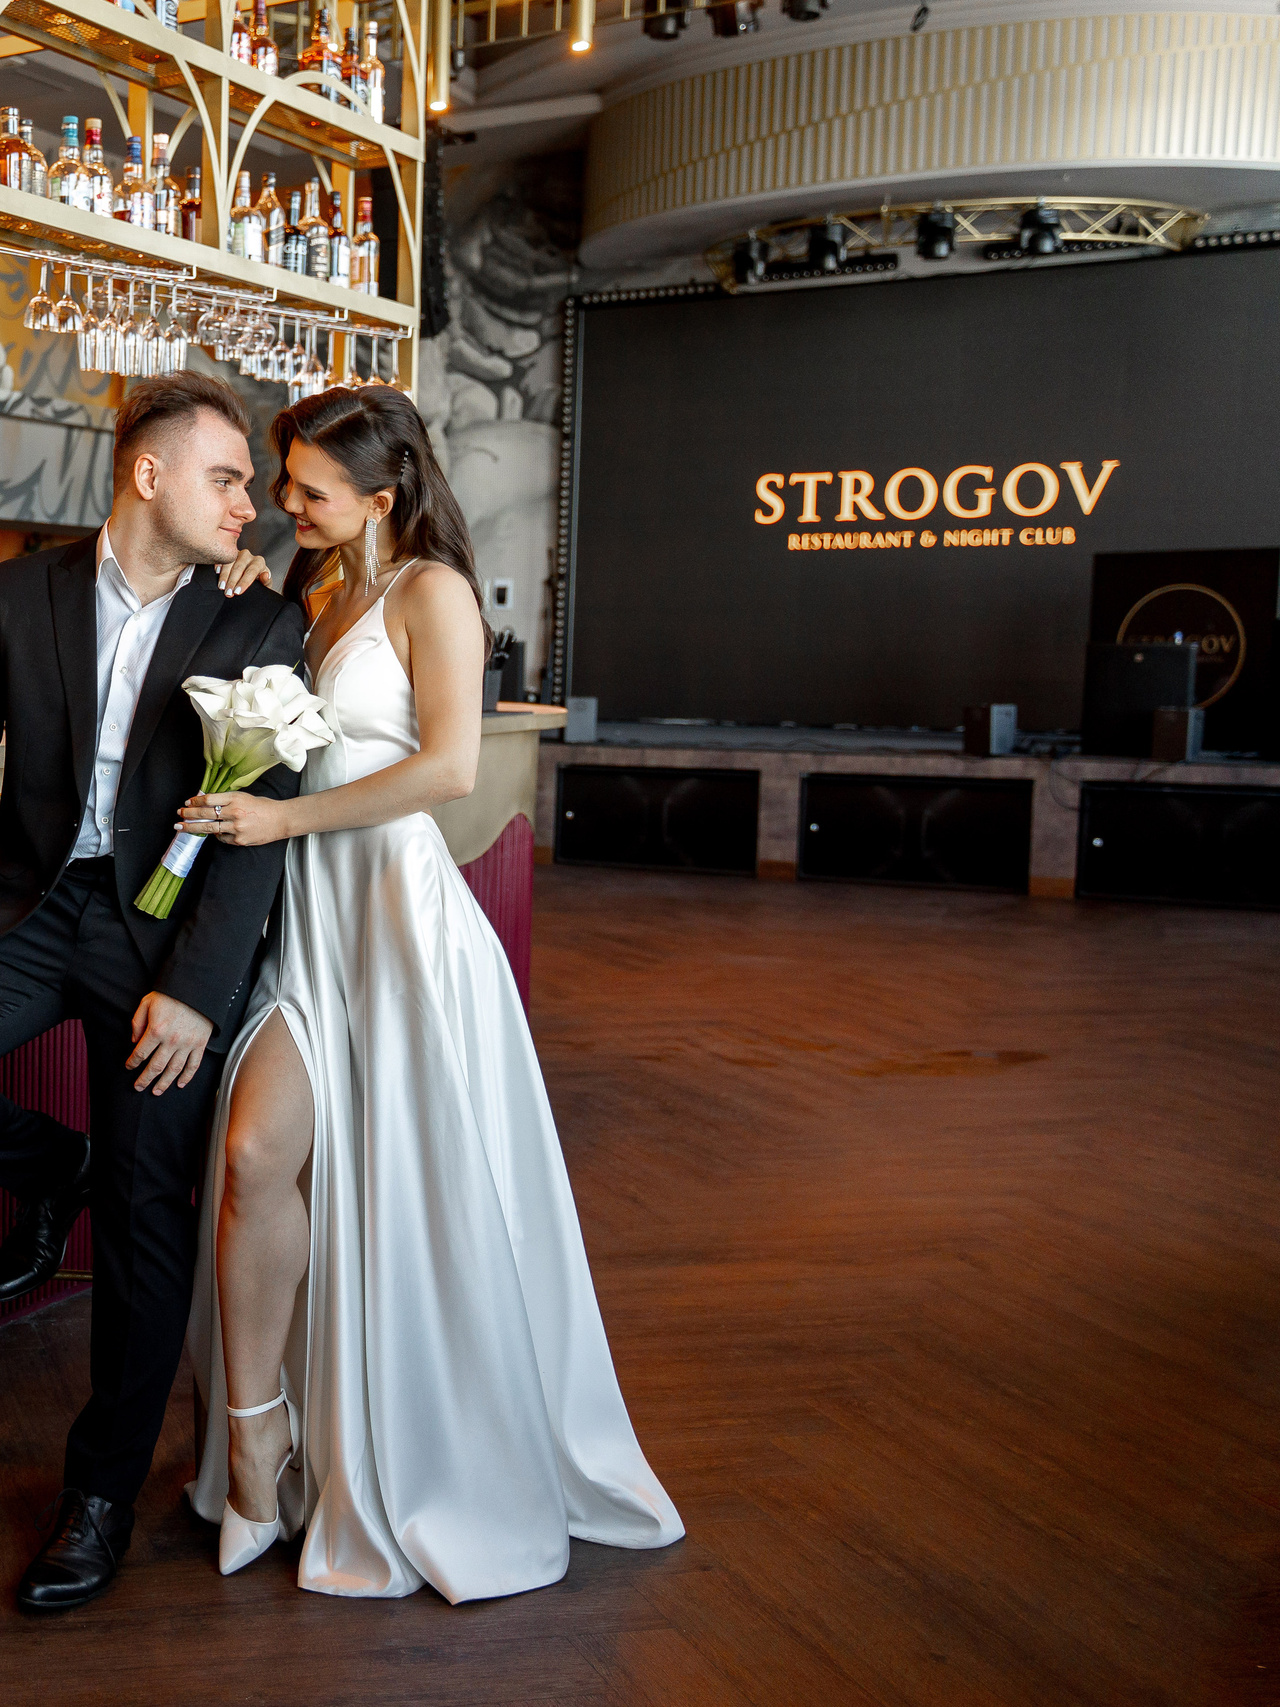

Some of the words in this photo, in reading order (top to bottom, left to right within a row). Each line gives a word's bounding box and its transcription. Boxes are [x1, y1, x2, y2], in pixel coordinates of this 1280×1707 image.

[754, 458, 1121, 525] STROGOV
[787, 530, 915, 551] RESTAURANT
[919, 530, 938, 548] &
[943, 528, 1014, 547] NIGHT
[1019, 526, 1076, 545] CLUB
